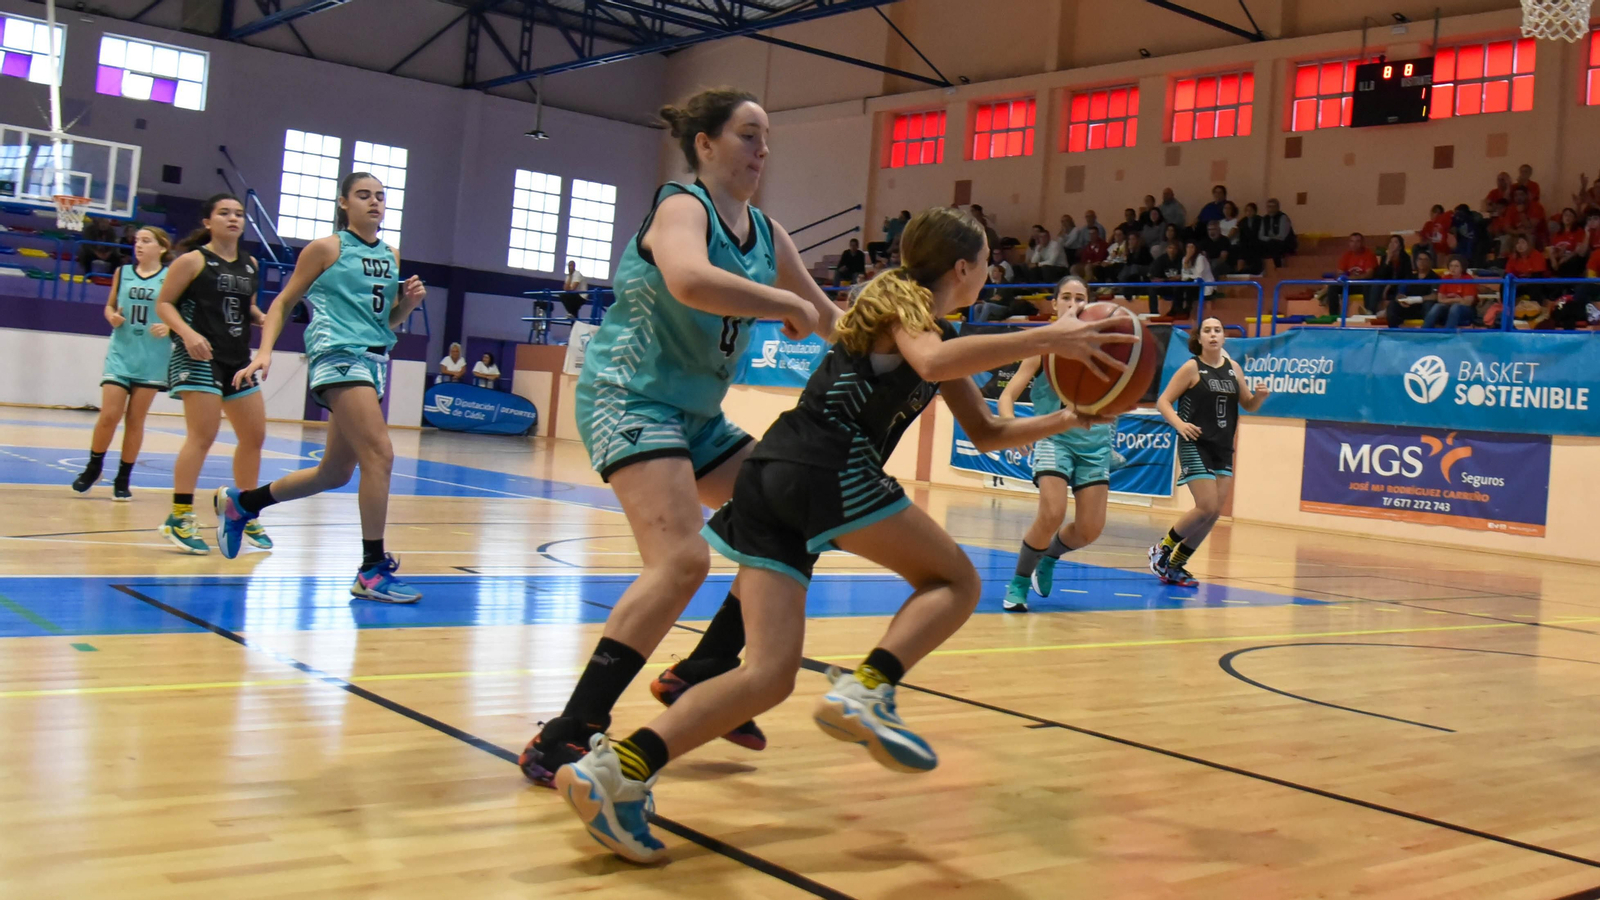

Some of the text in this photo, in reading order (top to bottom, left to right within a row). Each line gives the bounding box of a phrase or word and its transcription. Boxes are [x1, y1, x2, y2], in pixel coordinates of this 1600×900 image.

[1383, 64, 1413, 78] 8 8
[371, 284, 385, 314] 5
[130, 304, 148, 326] 14
[1243, 353, 1334, 375] baloncesto
[1457, 360, 1540, 384] BASKET
[1454, 383, 1590, 410] SOSTENIBLE
[452, 408, 486, 421] de Cádiz
[454, 397, 537, 419] Diputación DEPORTES
[1338, 442, 1423, 478] MGS
[1348, 481, 1369, 492] JOSÉ
[1461, 471, 1505, 487] Seguros
[1393, 498, 1411, 509] 677
[1413, 499, 1432, 511] 272
[1433, 500, 1451, 512] 743
